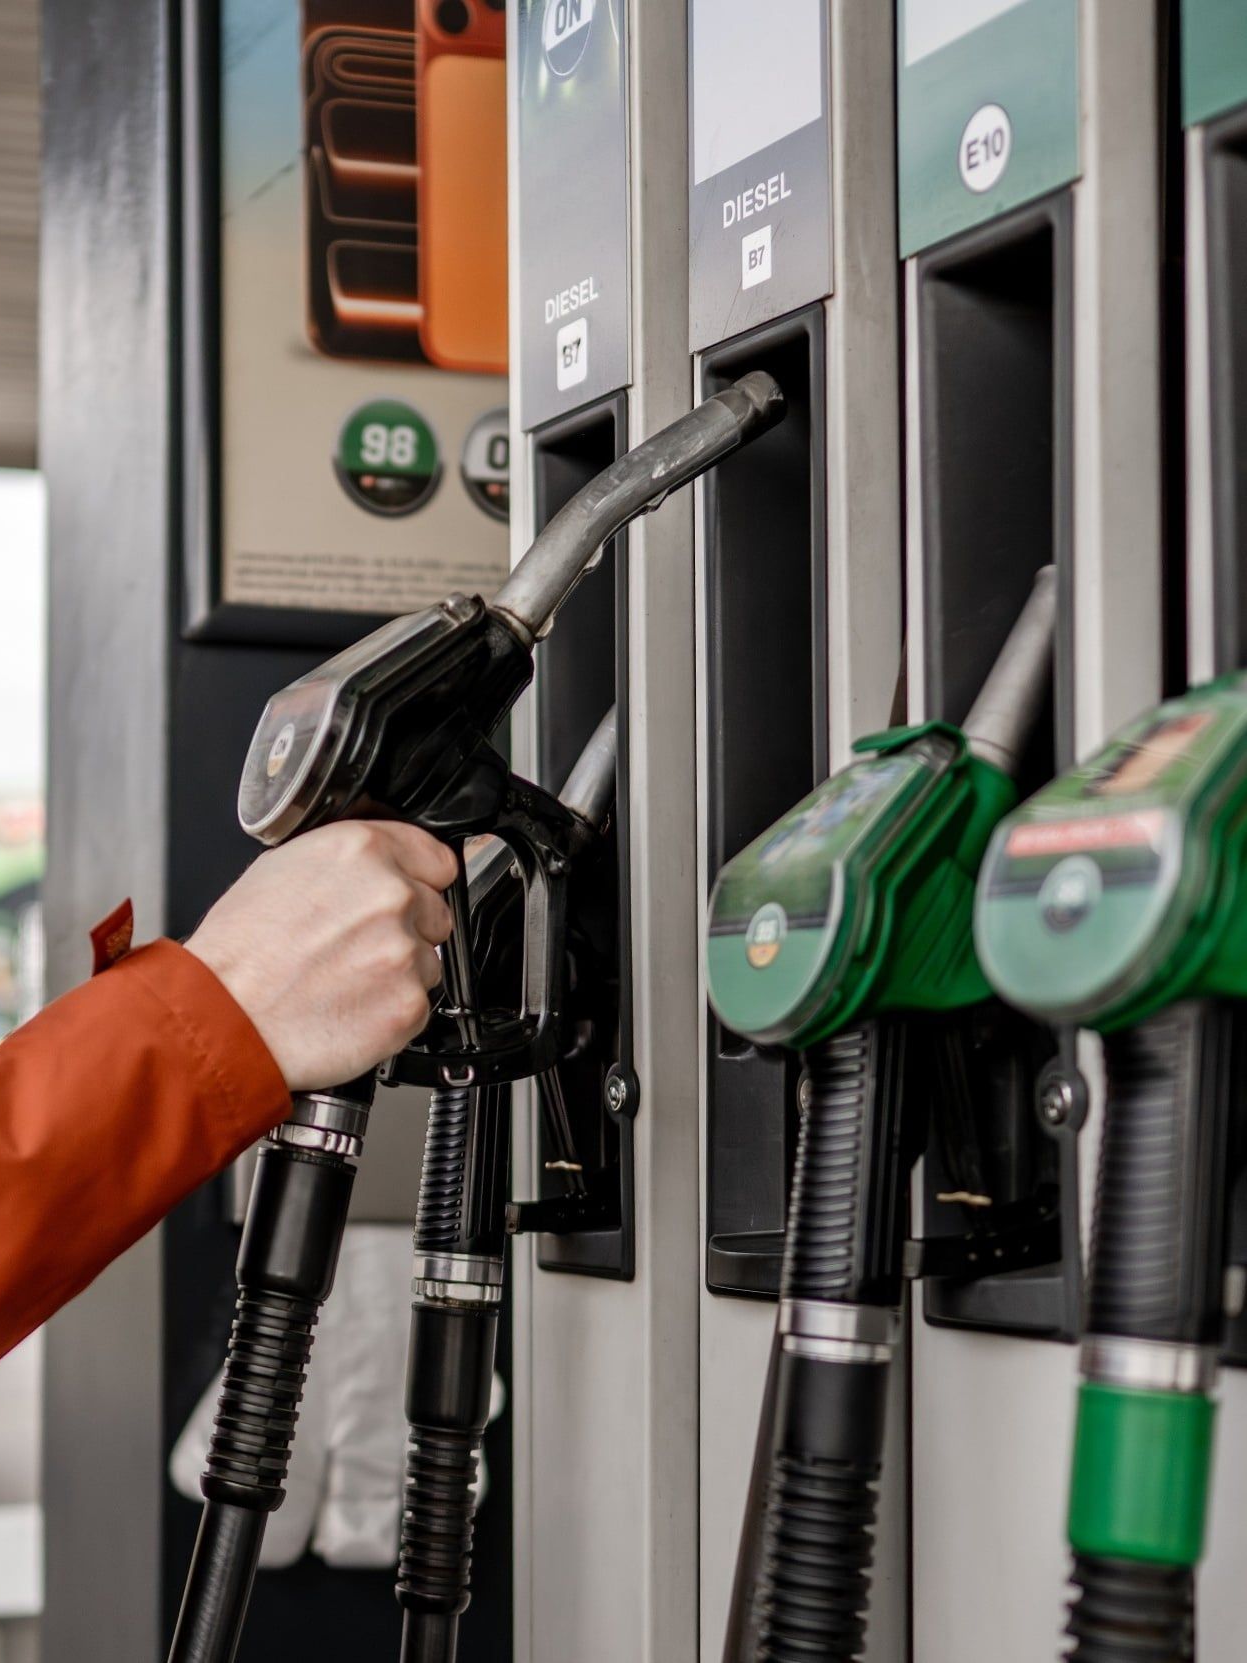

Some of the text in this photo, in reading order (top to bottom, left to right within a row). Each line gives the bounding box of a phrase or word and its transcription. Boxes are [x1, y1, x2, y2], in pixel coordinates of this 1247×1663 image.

[966, 127, 1004, 171] E10
[723, 171, 792, 229] DIESEL
[748, 245, 766, 271] B7
[545, 276, 599, 324] DIESEL
[562, 337, 582, 369] B7
[361, 423, 417, 467] 98
